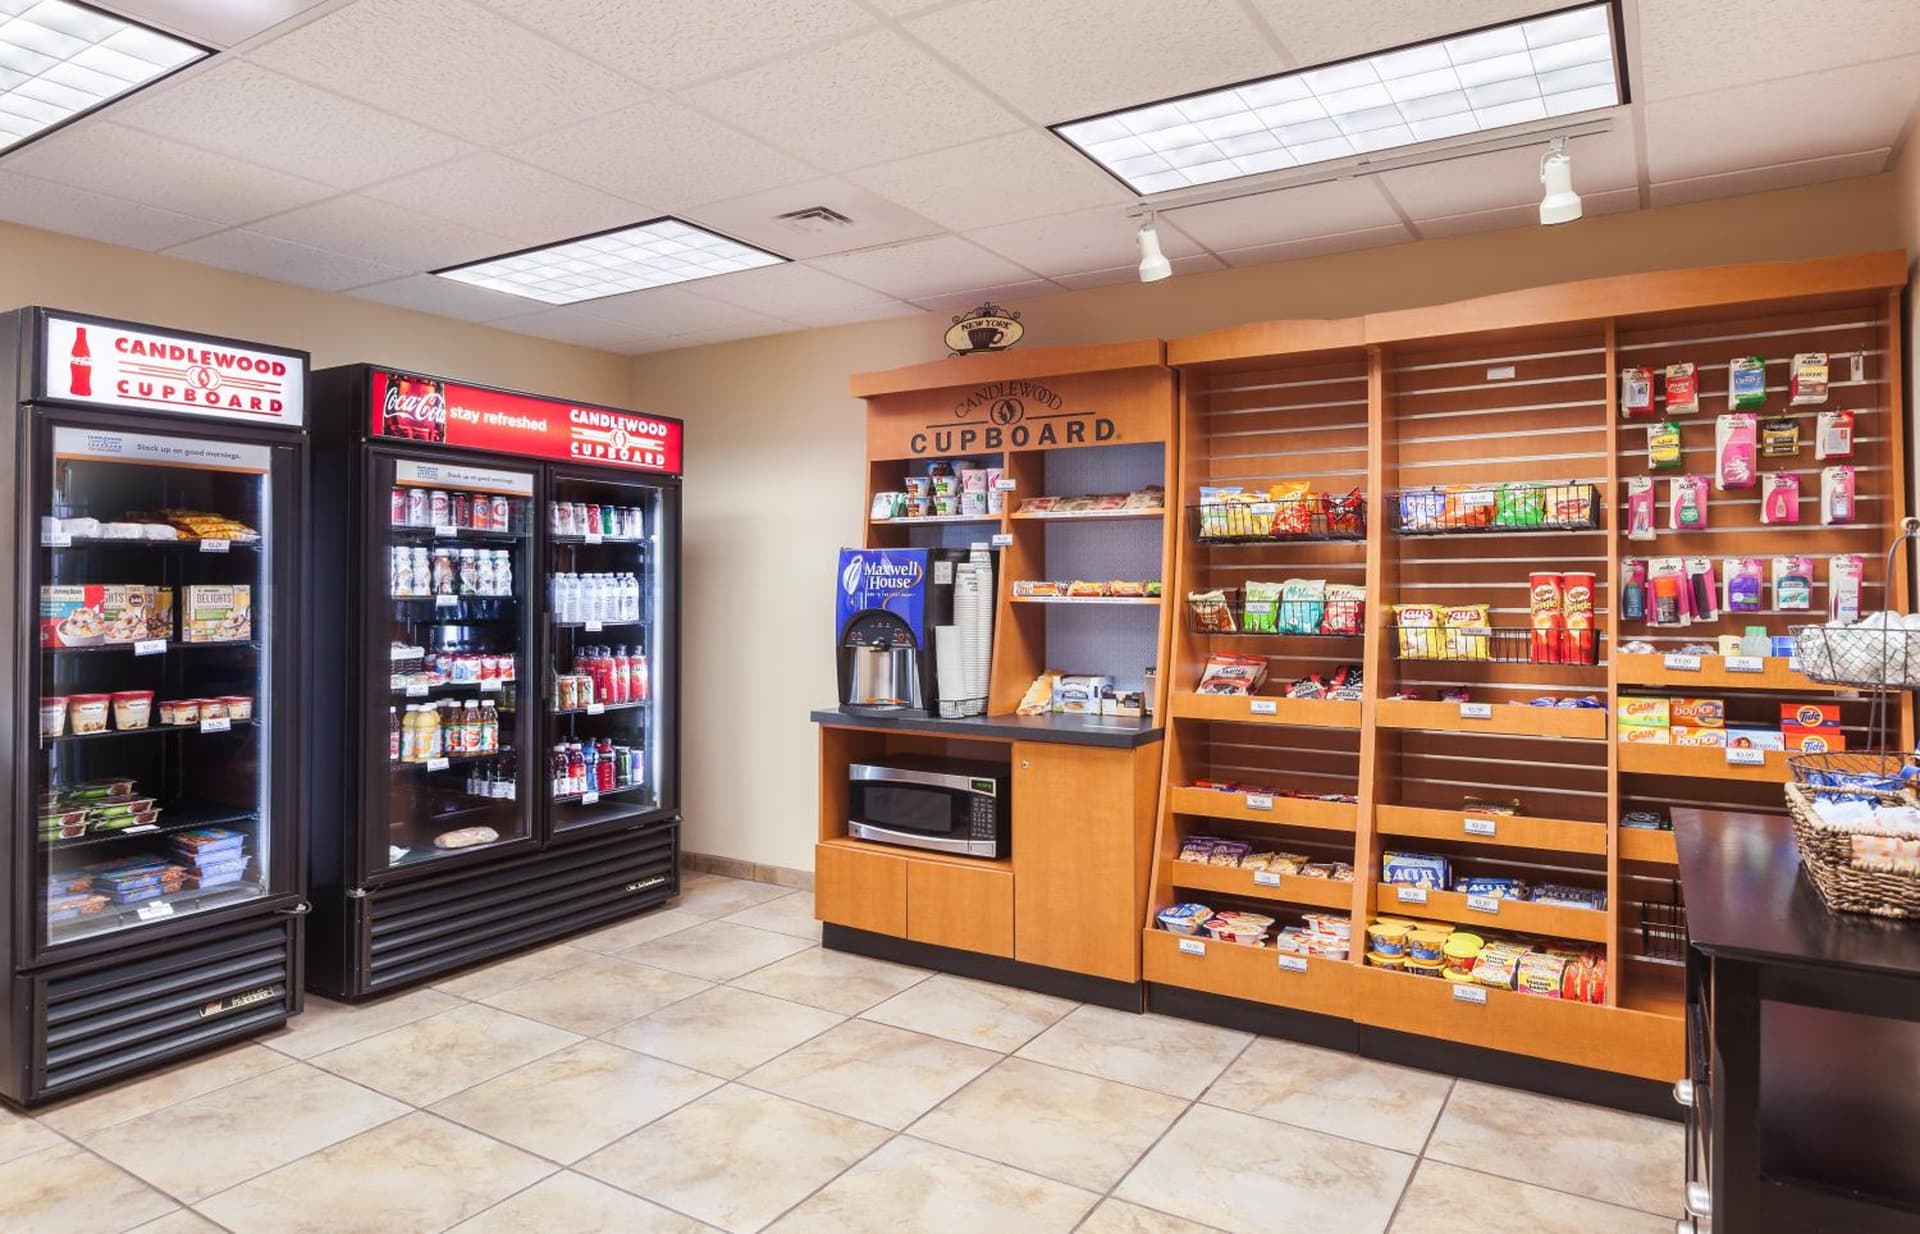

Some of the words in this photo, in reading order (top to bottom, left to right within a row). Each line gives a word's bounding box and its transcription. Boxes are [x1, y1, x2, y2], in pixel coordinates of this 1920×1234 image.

[960, 319, 984, 331] NEW
[985, 319, 1013, 329] YORK
[115, 337, 287, 376] CANDLEWOOD
[116, 379, 284, 413] CUPBOARD
[954, 381, 1064, 419] CANDLEWOOD
[450, 406, 481, 424] stay
[483, 411, 548, 432] refreshed
[570, 409, 668, 437] CANDLEWOOD
[910, 418, 1117, 454] CUPBOARD
[136, 443, 159, 452] Stock
[160, 446, 172, 454] up
[184, 449, 205, 457] good
[570, 441, 665, 466] CUPBOARD
[864, 560, 918, 577] Maxwell
[870, 576, 912, 590] House
[1627, 702, 1656, 715] GAIN
[1800, 710, 1821, 722] Tide
[1627, 729, 1656, 742] GAIN
[1803, 740, 1825, 752] Tide
[1393, 867, 1421, 881] ACT
